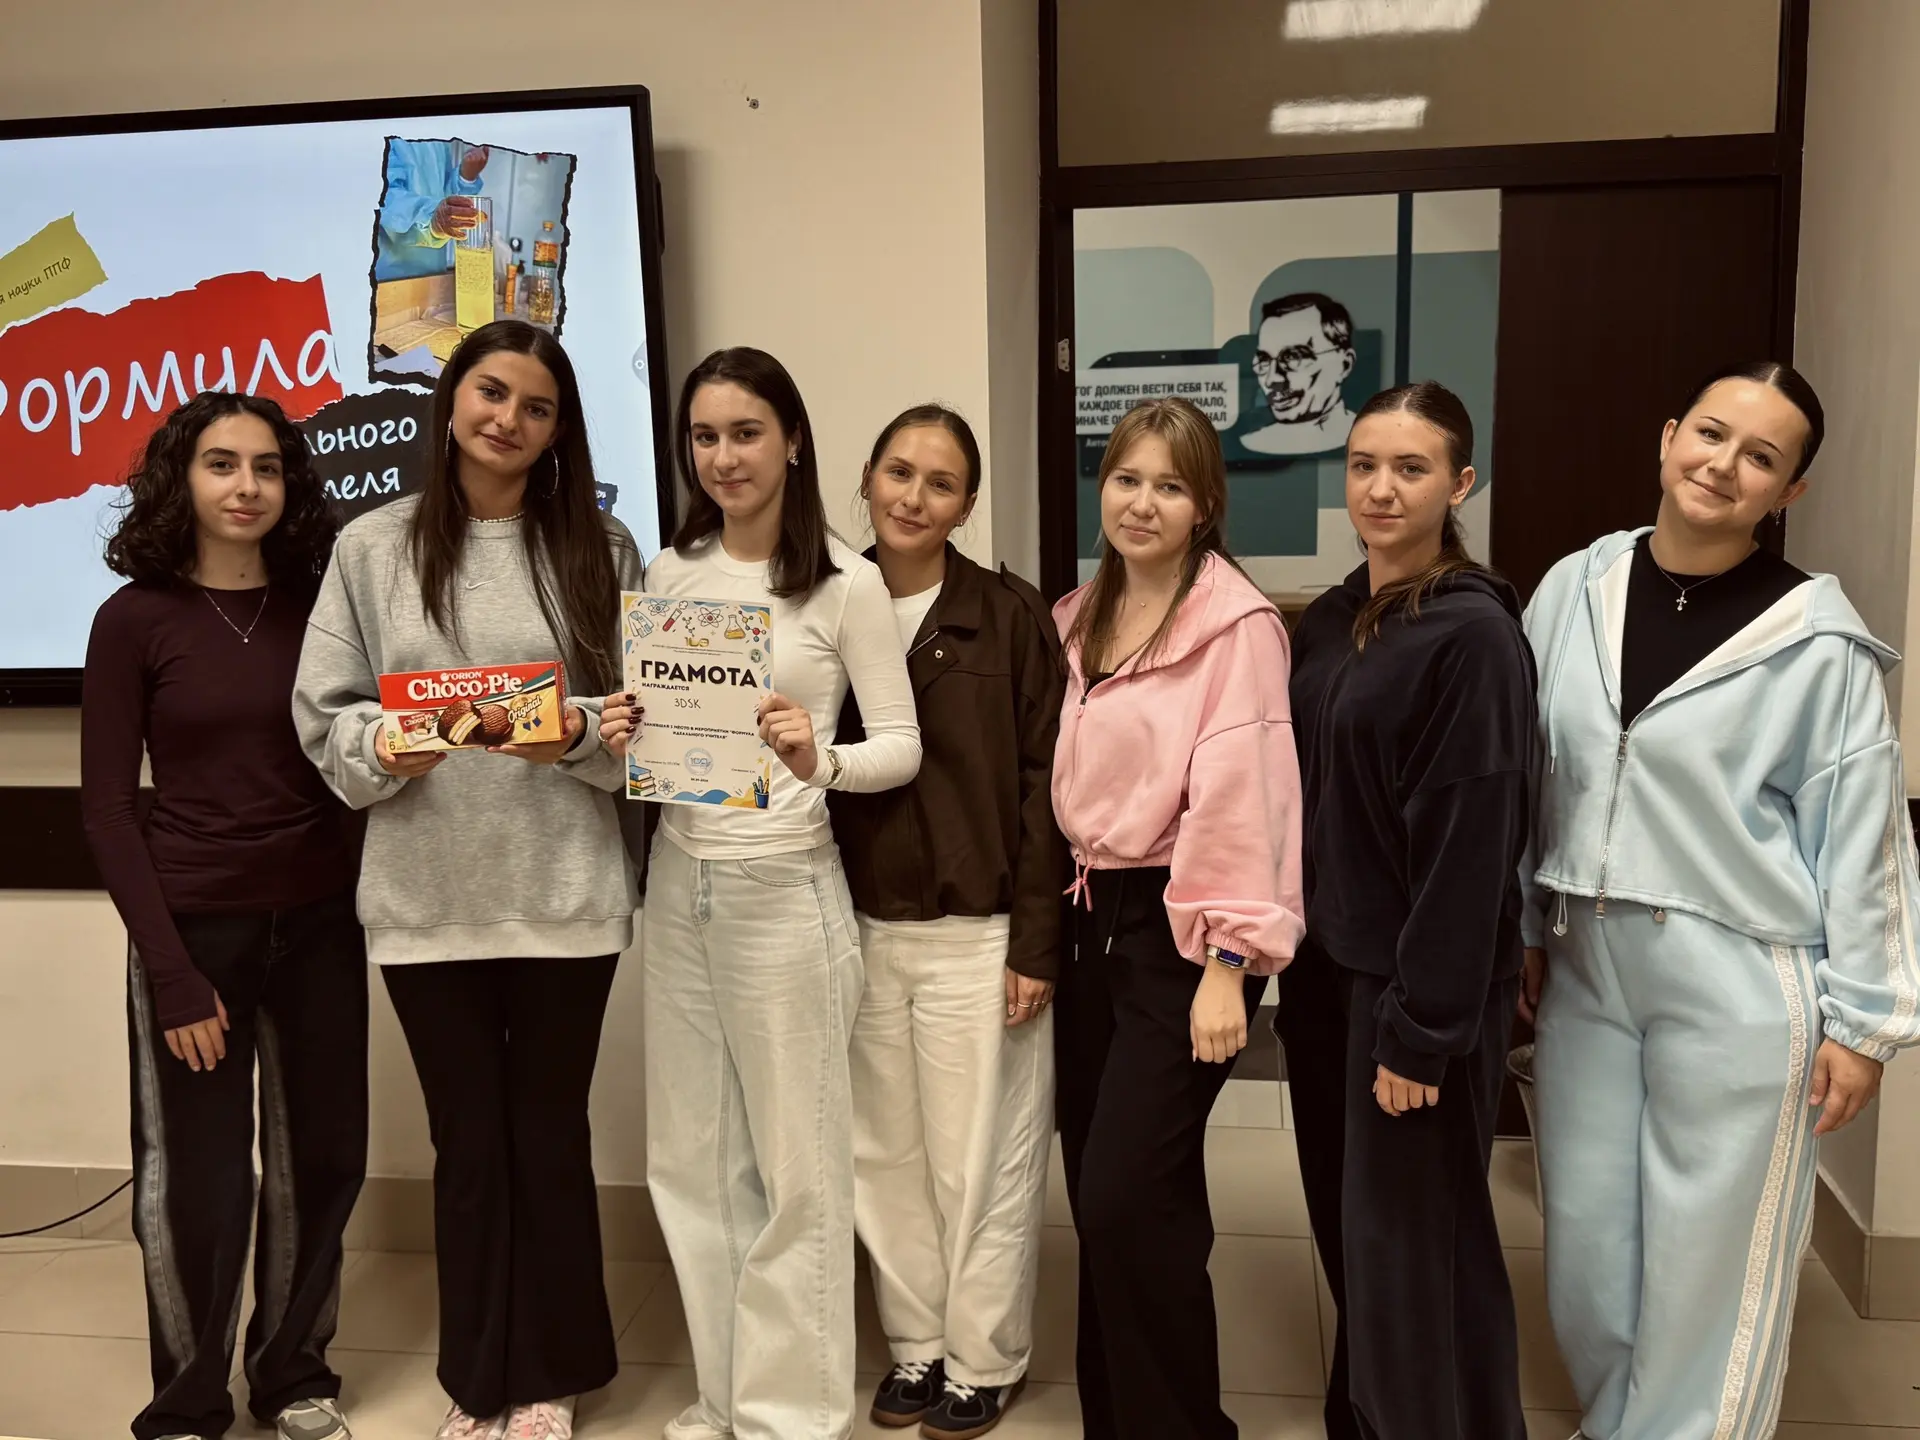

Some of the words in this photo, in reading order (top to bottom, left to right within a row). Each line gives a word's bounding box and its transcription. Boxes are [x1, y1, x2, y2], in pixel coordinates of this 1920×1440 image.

[8, 276, 42, 295] науки
[44, 257, 71, 279] ППФ
[0, 330, 342, 456] ормула
[1095, 384, 1139, 398] ДОЛЖЕН
[1142, 384, 1174, 394] ВЕСТИ
[1177, 382, 1201, 393] СЕБЯ
[1205, 381, 1227, 393] ТАК,
[1079, 400, 1122, 412] КАЖДОЕ
[1076, 415, 1109, 426] ИНАЧЕ
[450, 671, 483, 681] ORION
[641, 660, 758, 688] ГРАМОТА
[642, 682, 690, 691] НАГРАЖДАЕТСЯ
[508, 695, 542, 724] Original
[389, 741, 396, 750] 6
